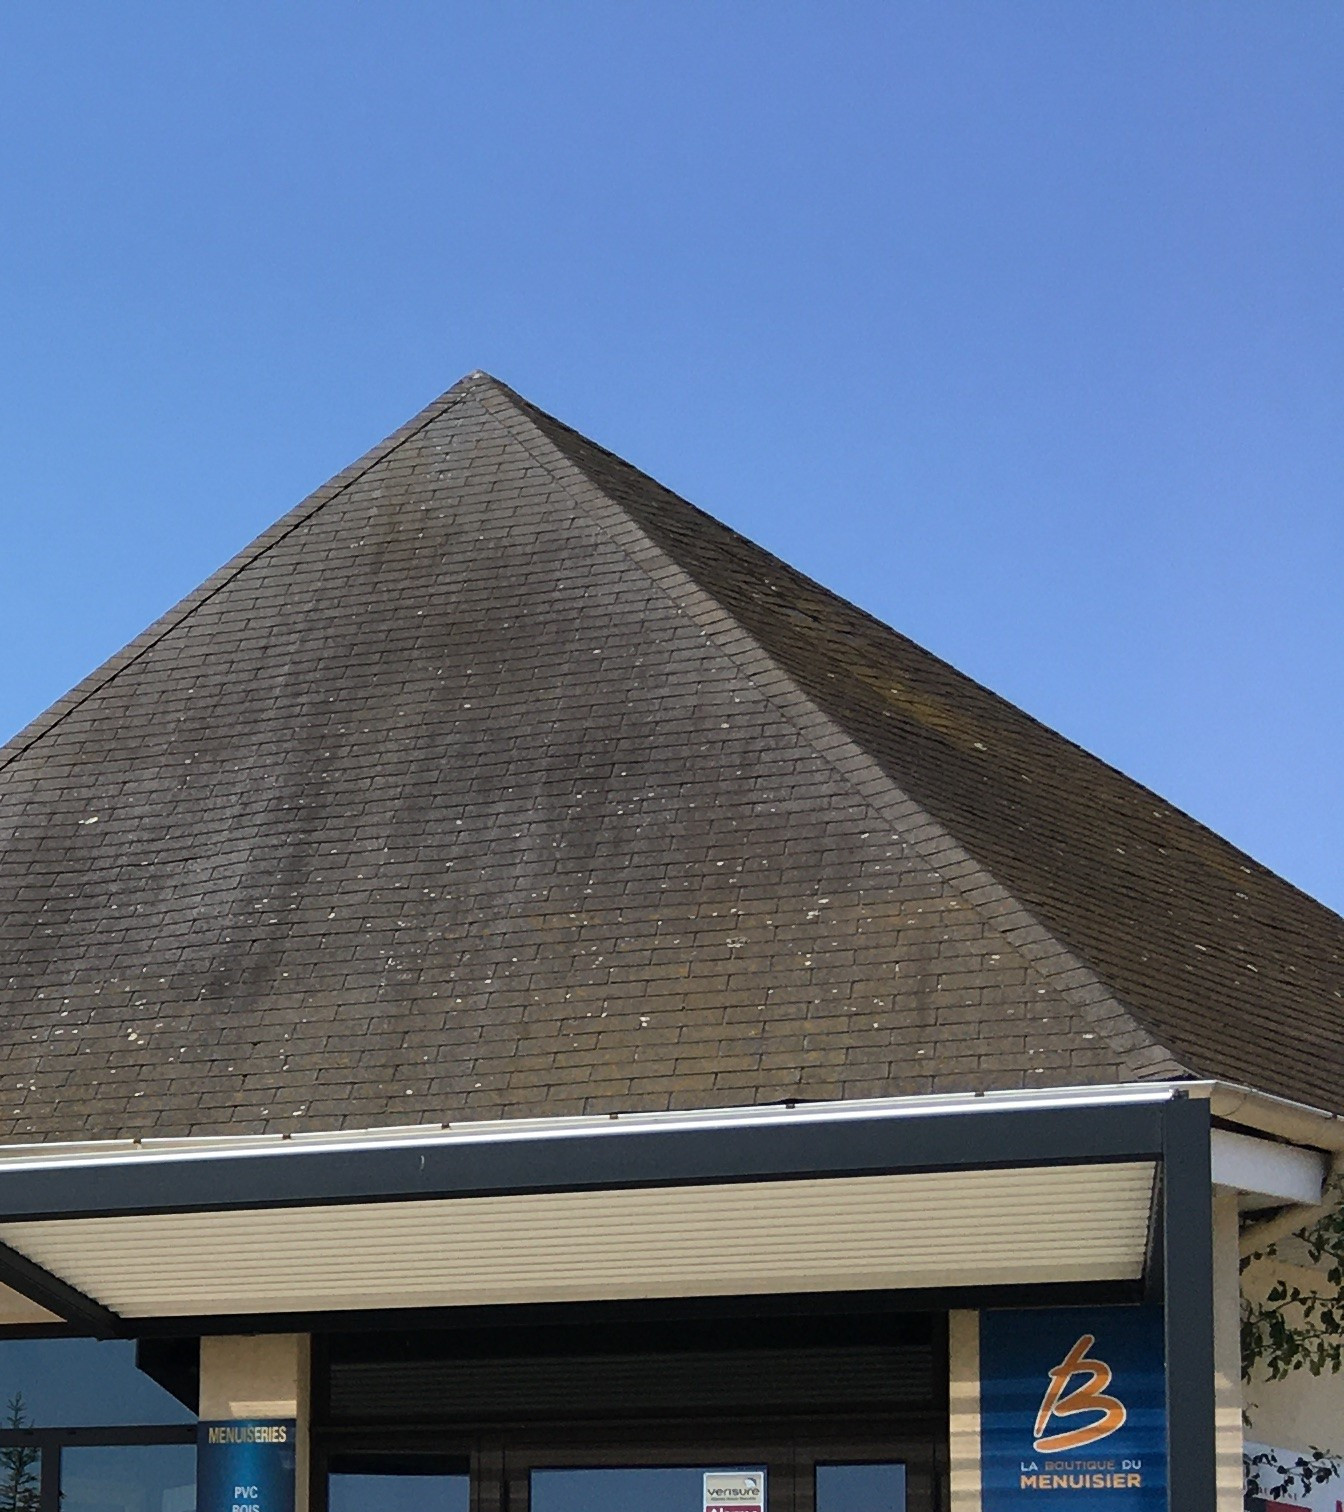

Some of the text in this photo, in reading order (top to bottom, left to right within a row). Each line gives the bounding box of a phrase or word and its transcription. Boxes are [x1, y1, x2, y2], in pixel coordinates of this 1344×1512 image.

[208, 1426, 287, 1444] MENUISERIES
[1020, 1459, 1142, 1472] LA BOUTIQUE DU
[1020, 1473, 1142, 1489] MENUISIER
[234, 1486, 258, 1499] PVC
[707, 1487, 760, 1496] verisure
